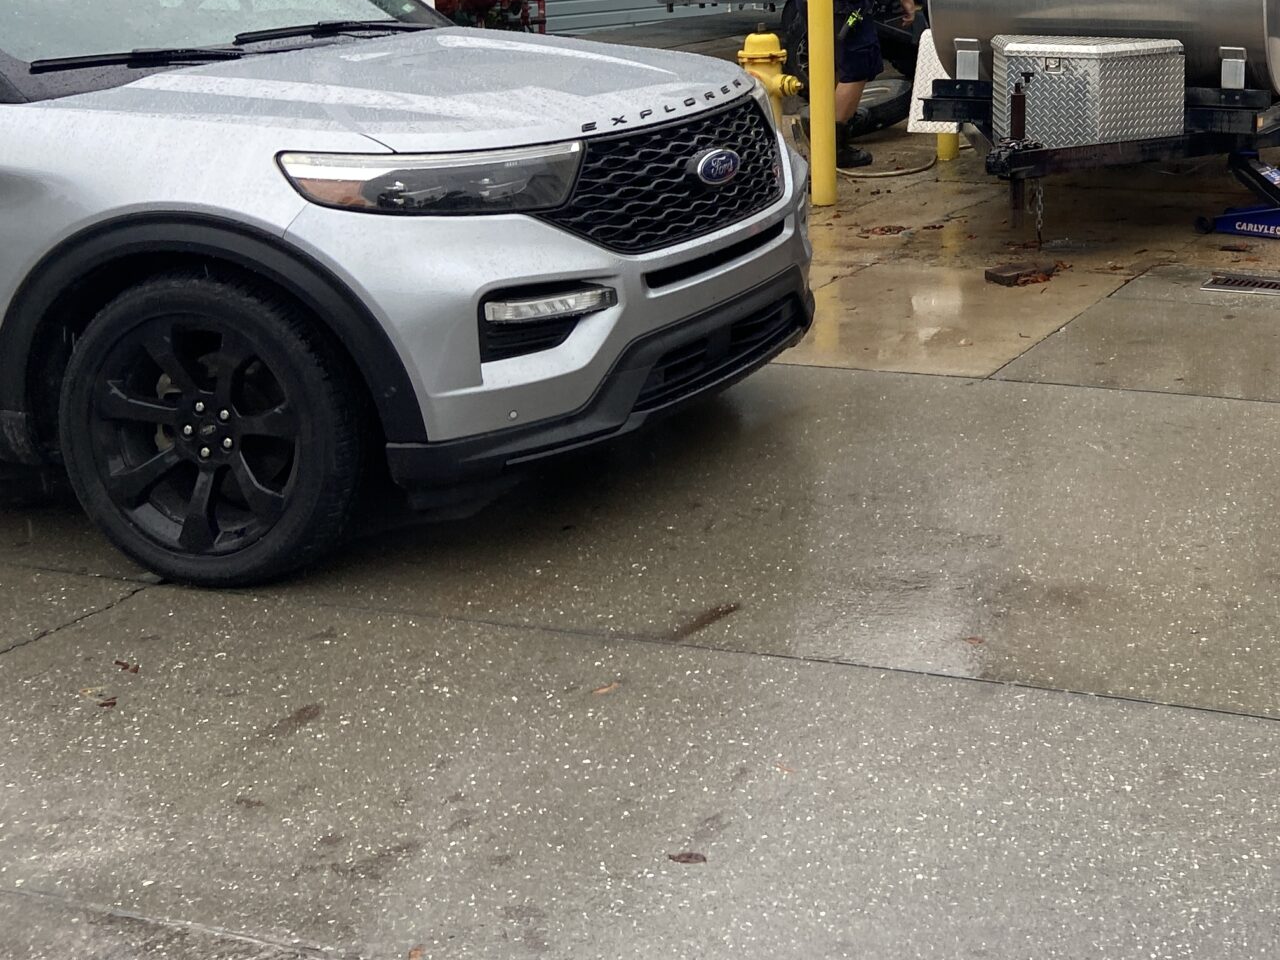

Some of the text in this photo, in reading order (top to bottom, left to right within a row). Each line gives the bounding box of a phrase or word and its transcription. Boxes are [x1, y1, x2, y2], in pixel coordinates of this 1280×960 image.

[581, 78, 742, 133] EXPLORER
[710, 155, 735, 177] Ford
[1235, 221, 1276, 235] CARLYLE
